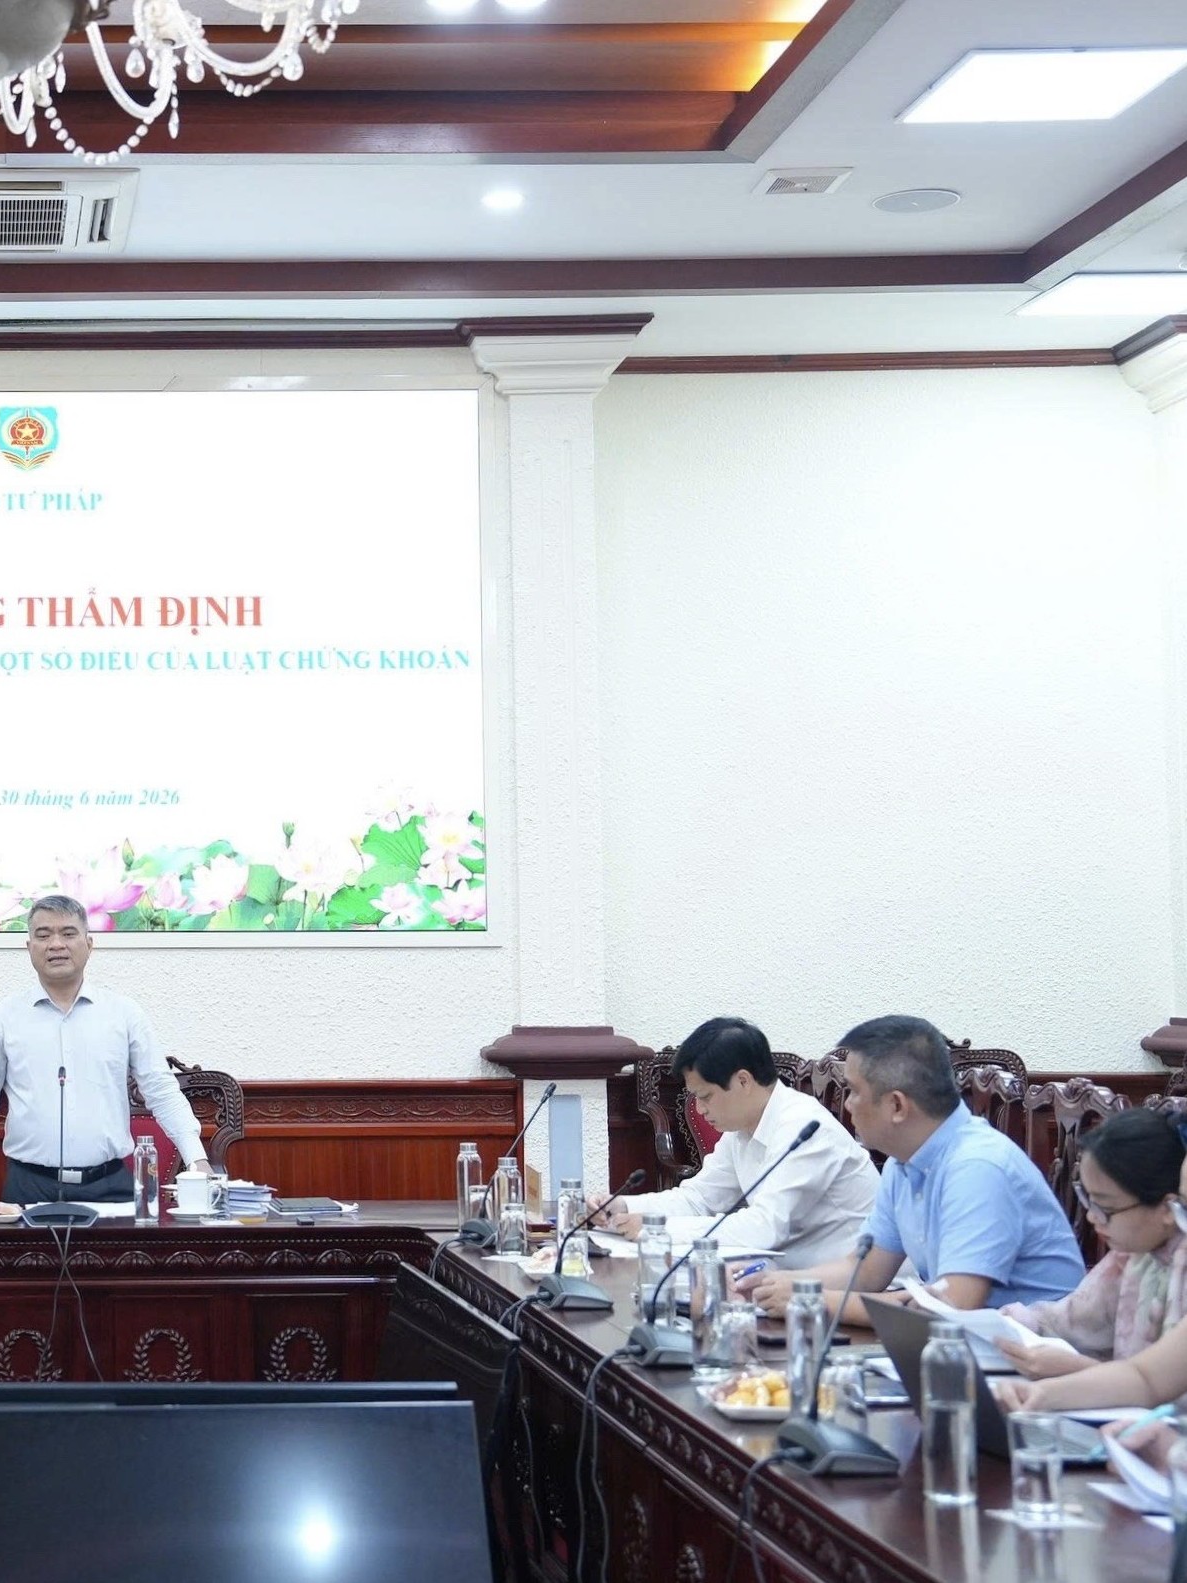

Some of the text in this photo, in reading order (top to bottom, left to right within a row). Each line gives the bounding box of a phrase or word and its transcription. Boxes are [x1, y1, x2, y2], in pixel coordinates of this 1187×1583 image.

[41, 488, 104, 511] PHÁP
[18, 586, 143, 628] THẨM
[157, 596, 263, 636] ĐỊNH
[79, 788, 90, 806] 6
[138, 788, 181, 806] 2026
